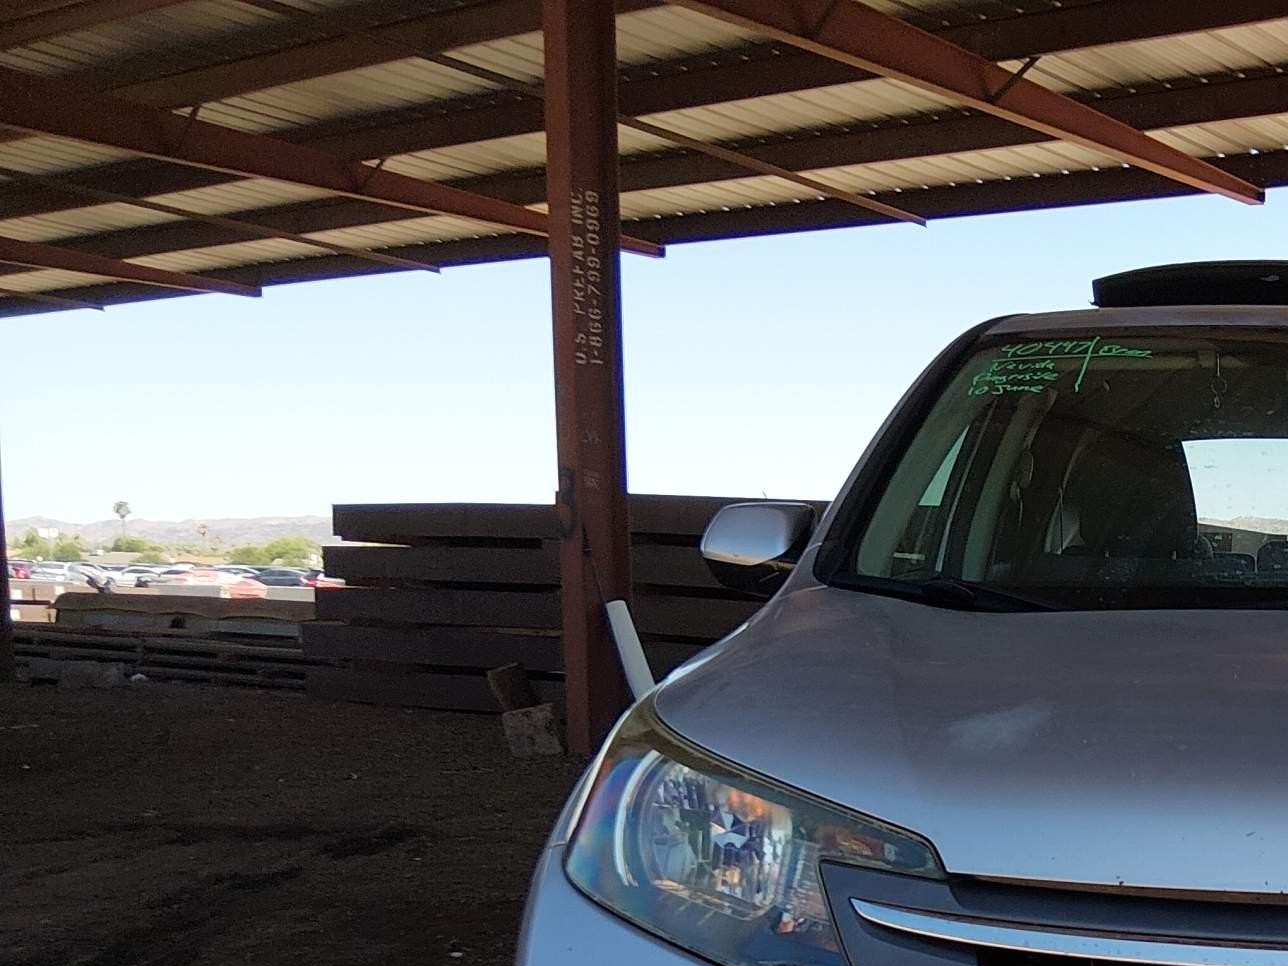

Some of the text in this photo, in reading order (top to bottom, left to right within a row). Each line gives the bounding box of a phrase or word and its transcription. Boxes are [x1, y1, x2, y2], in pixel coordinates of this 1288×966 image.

[571, 235, 586, 315] PREFAB
[968, 384, 1044, 396] 10 June
